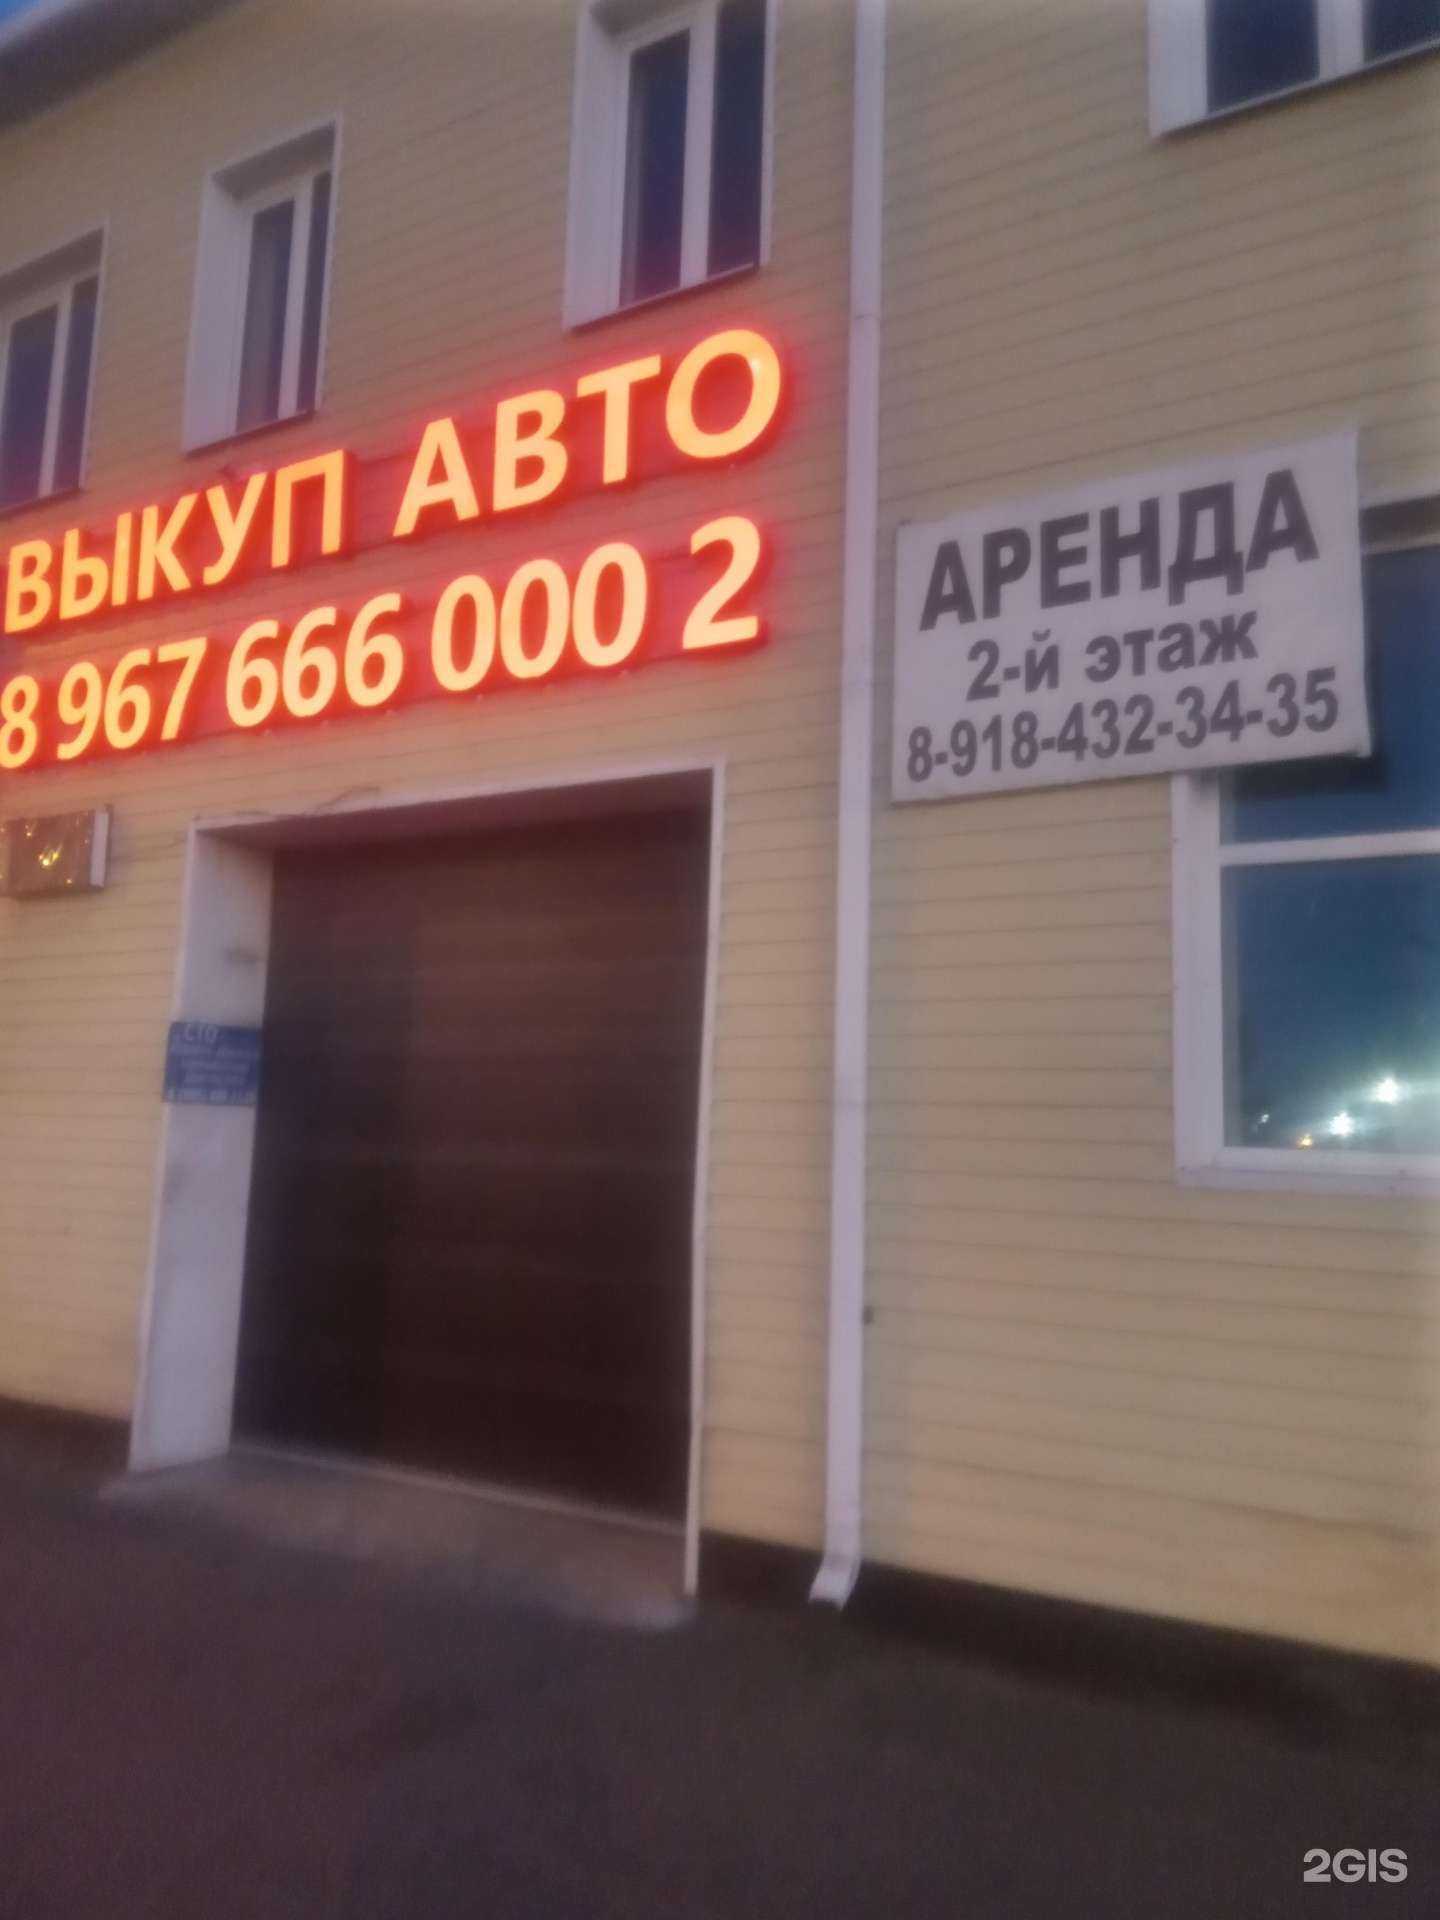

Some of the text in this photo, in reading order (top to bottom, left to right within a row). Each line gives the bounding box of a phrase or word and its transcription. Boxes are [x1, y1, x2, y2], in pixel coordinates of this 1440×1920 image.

[5, 329, 782, 633] ВЫКУП АВТО
[919, 469, 1320, 631] АРЕНДА
[0, 516, 761, 769] 8 967 666 000 2
[966, 611, 1258, 701] 2-й этаж
[907, 666, 1338, 782] 8-918-432-34-35
